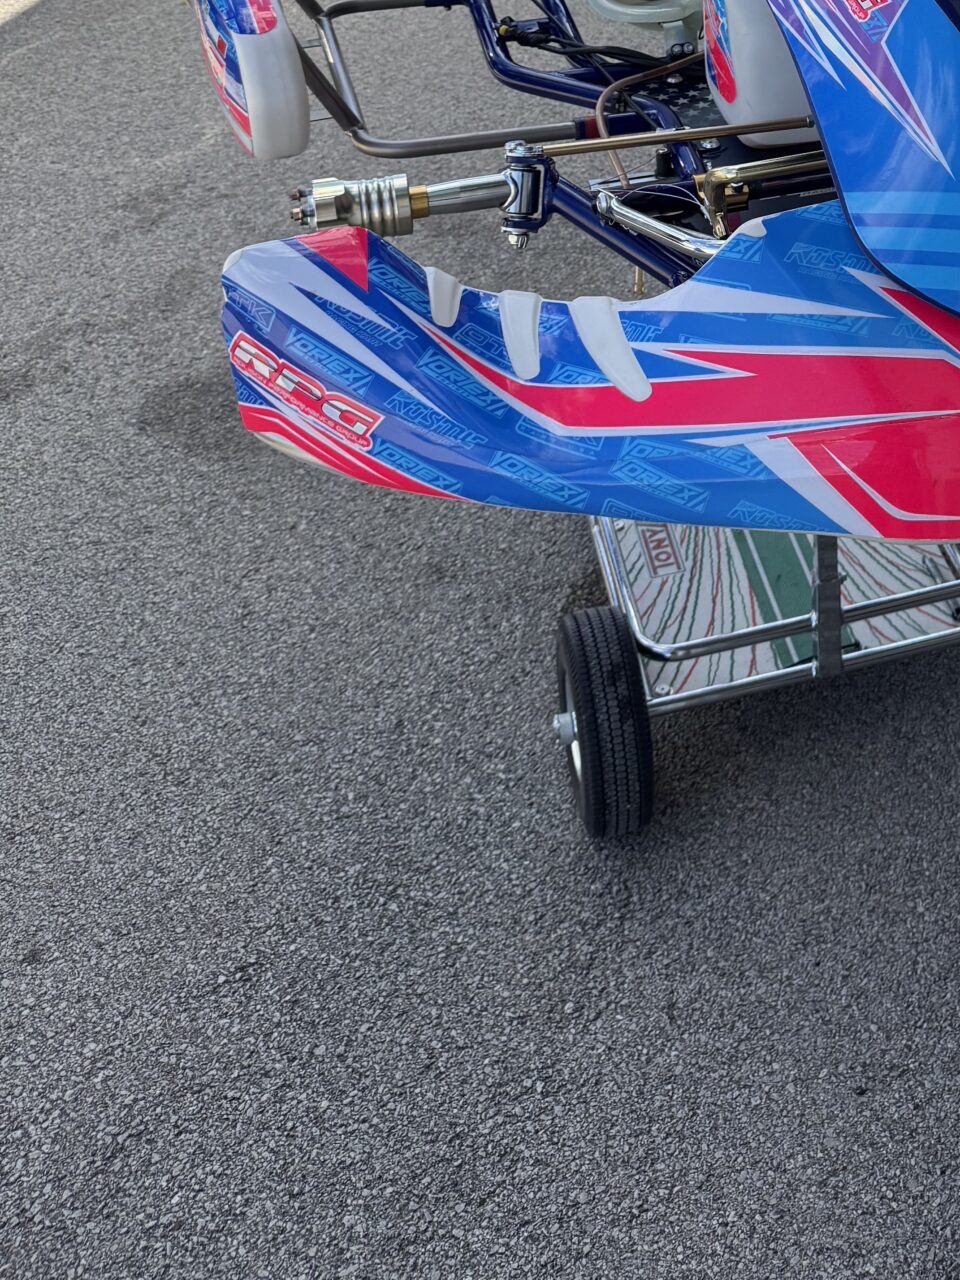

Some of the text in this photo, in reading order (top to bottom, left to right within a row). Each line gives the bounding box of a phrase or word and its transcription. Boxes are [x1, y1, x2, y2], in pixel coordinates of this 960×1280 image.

[368, 256, 431, 314] VORTE
[234, 339, 374, 436] RPG
[286, 326, 370, 392] VORTEX
[416, 346, 508, 416] VORTEX
[335, 425, 370, 448] GROUP
[372, 438, 462, 495] VORTEX
[489, 451, 589, 508] VORTEX
